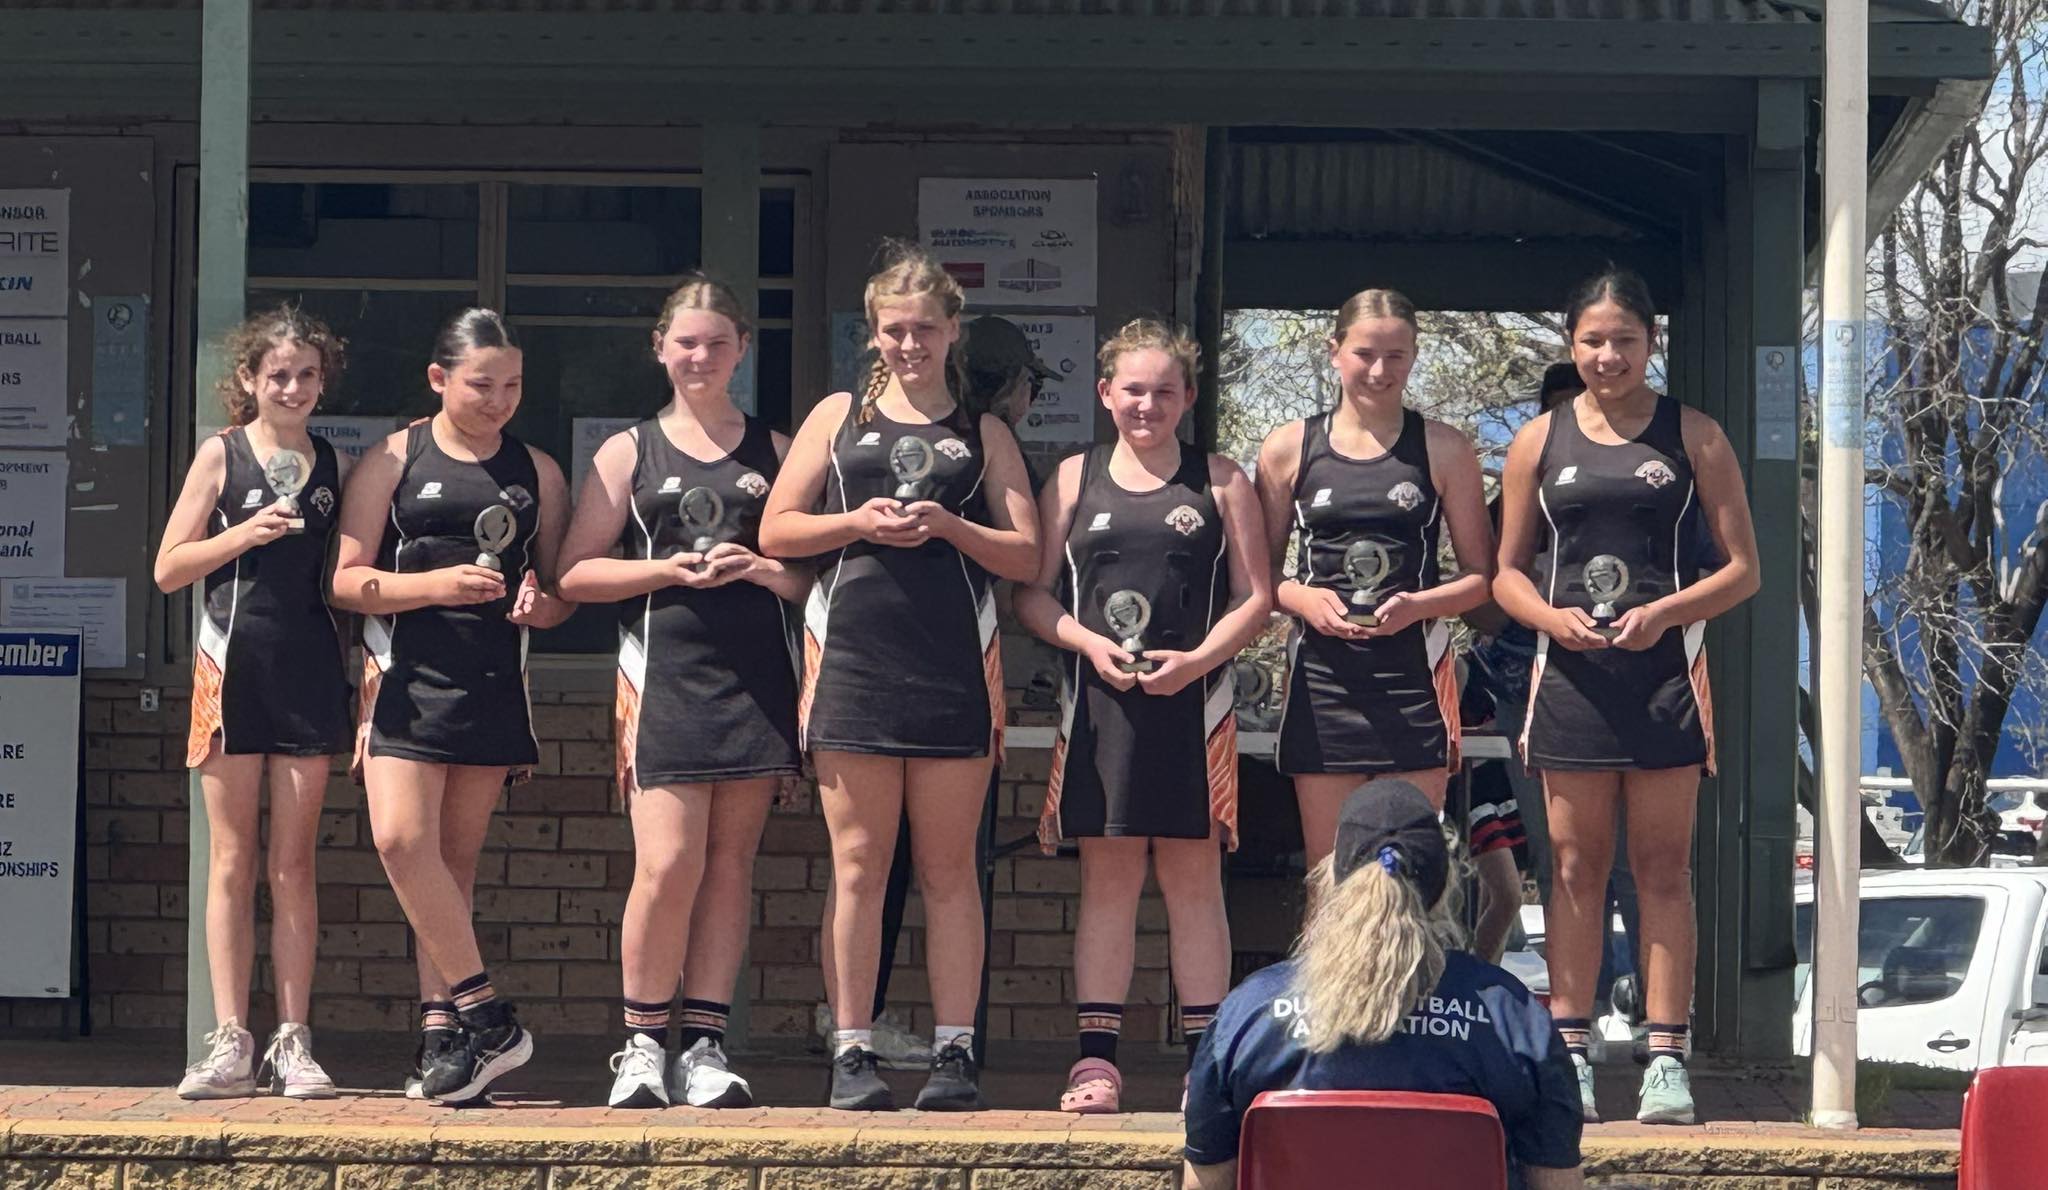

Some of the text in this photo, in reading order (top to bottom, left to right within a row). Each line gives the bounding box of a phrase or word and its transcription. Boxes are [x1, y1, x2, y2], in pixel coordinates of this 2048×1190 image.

[0, 206, 47, 220] NSOR
[0, 743, 25, 759] RE
[1416, 996, 1491, 1024] TBALL
